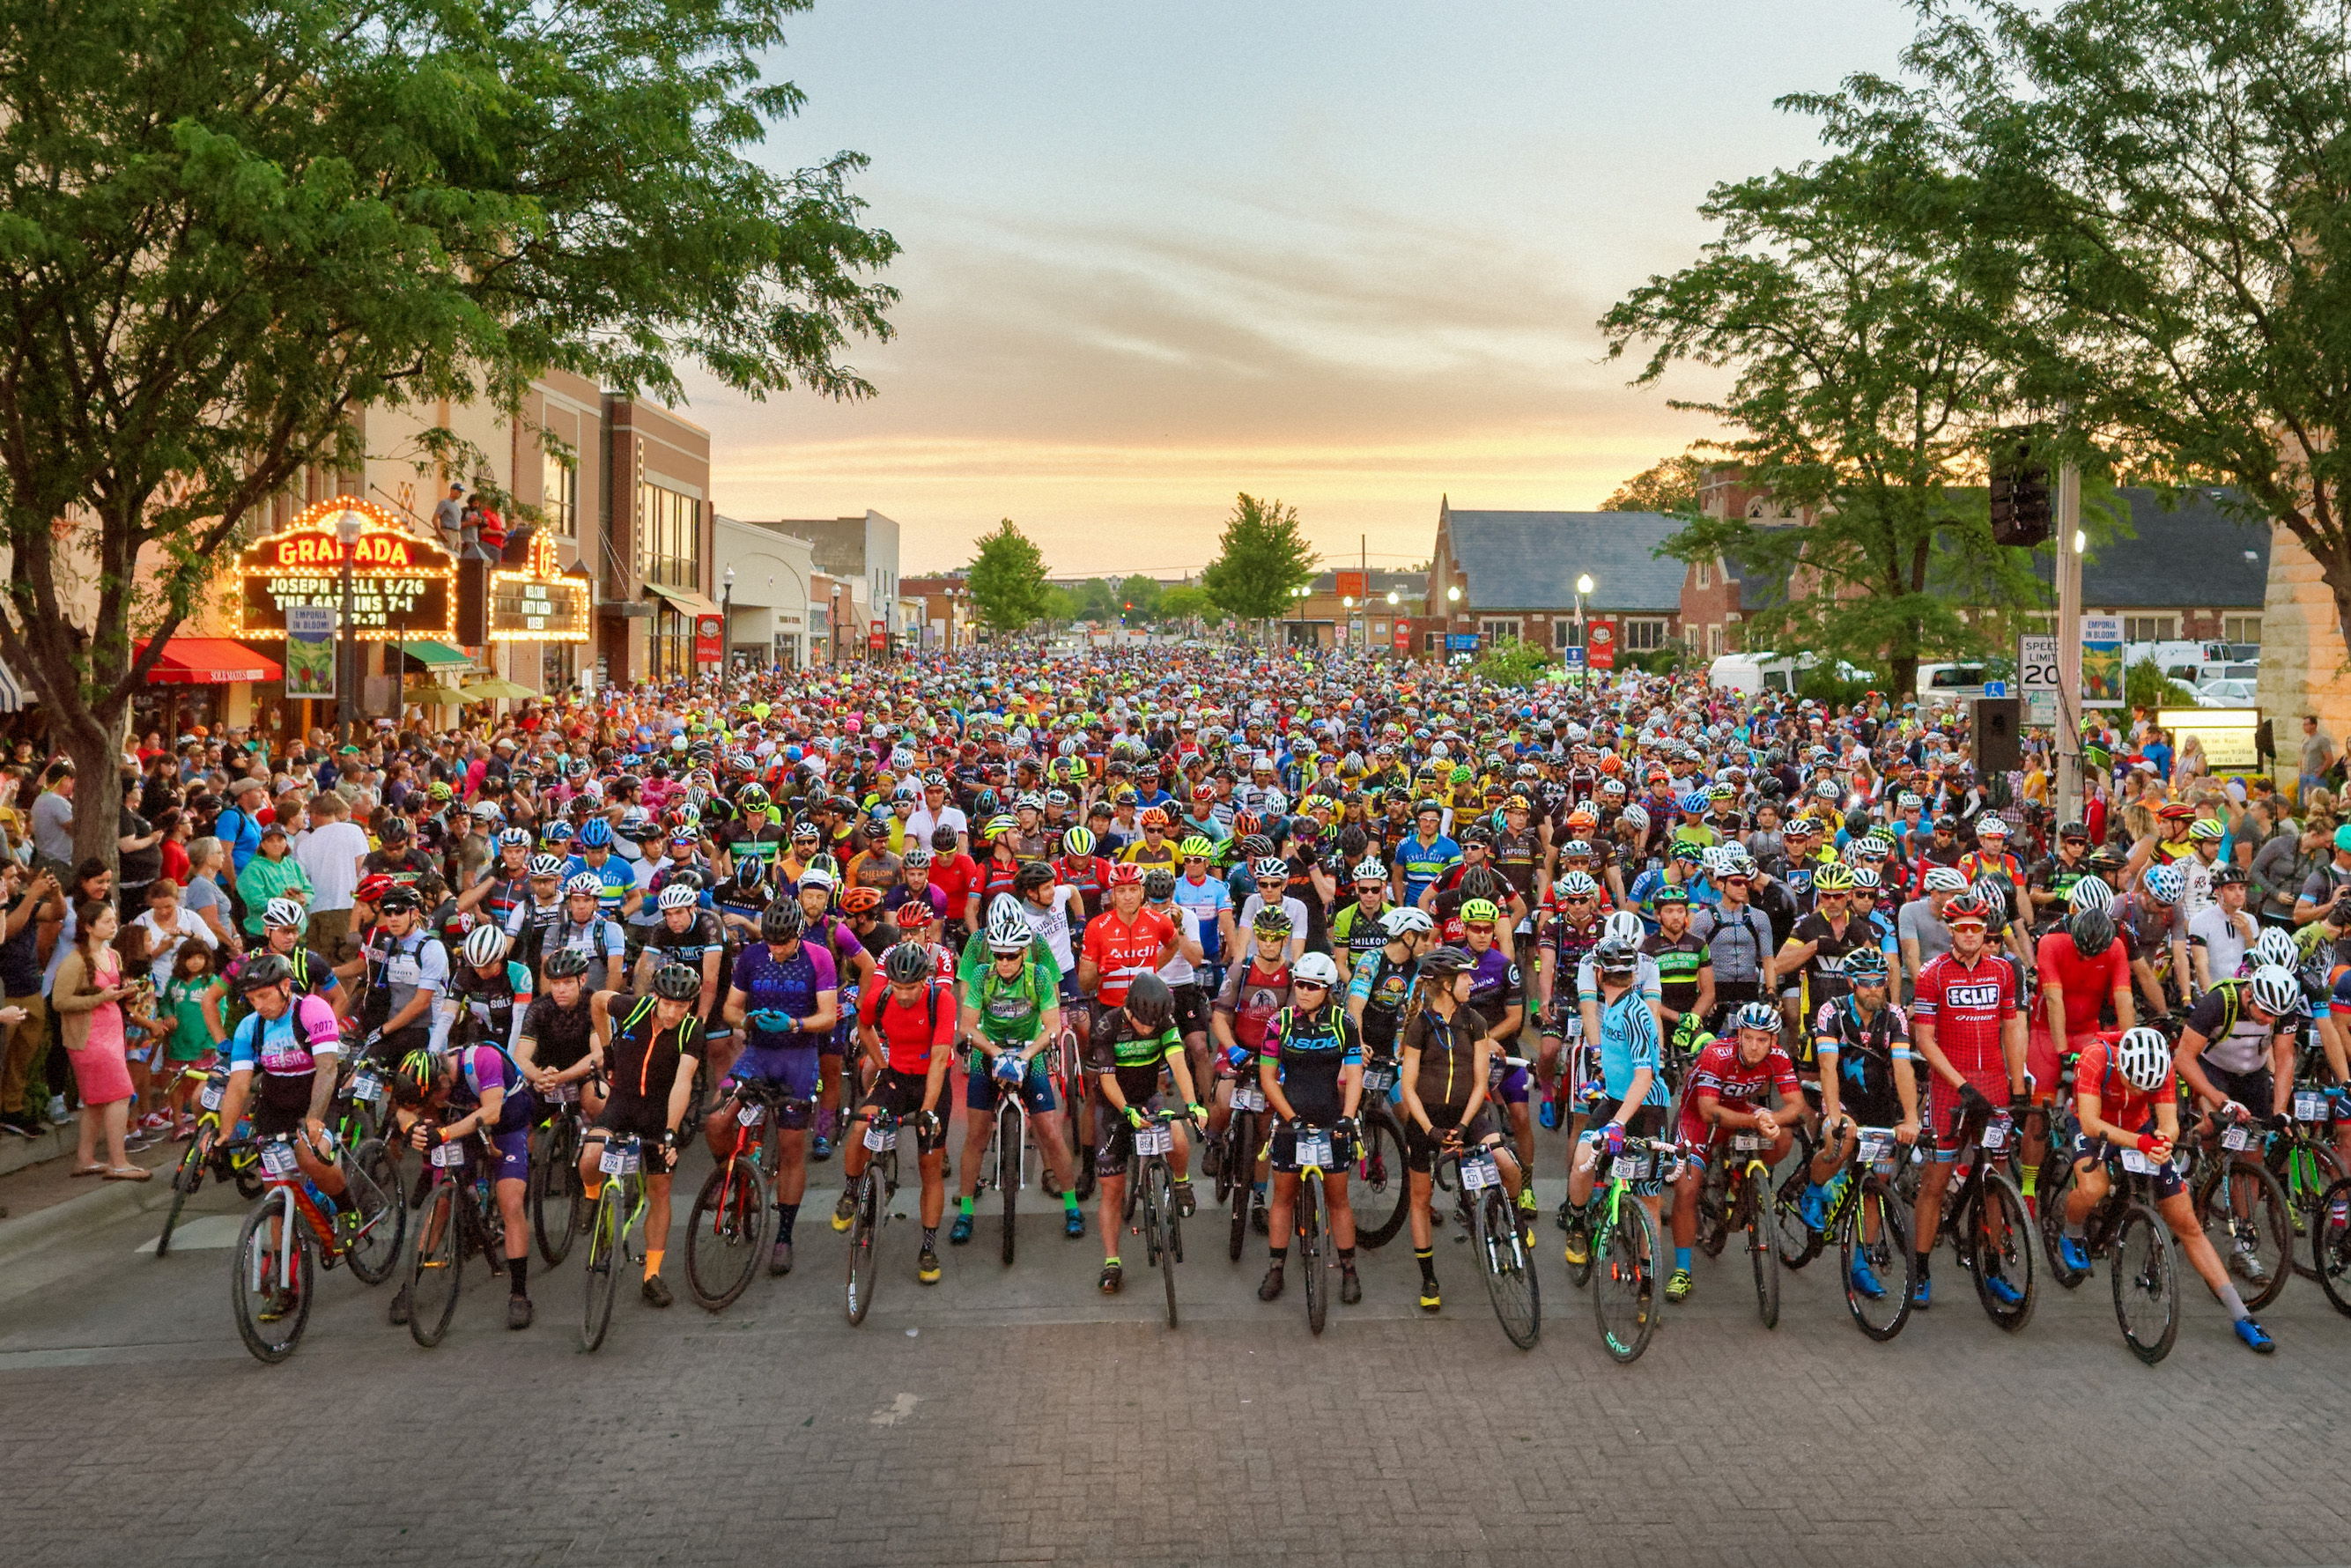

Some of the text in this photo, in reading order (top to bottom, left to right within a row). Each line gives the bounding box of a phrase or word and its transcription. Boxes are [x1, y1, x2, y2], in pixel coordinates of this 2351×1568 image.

[266, 578, 330, 594] JOSEPH
[384, 579, 425, 595] 5/26
[295, 610, 327, 619] EMPORIA
[292, 620, 329, 630] IN BLOOM!
[2088, 620, 2116, 629] EMPORIA
[2029, 654, 2057, 662] LIMIT
[1034, 911, 1066, 932] UBJECT
[1110, 945, 1155, 959] Audi
[1960, 988, 1998, 1005] CLIF
[314, 1020, 333, 1035] 2017
[1989, 1134, 2000, 1143] 194
[2229, 1135, 2242, 1144] 912
